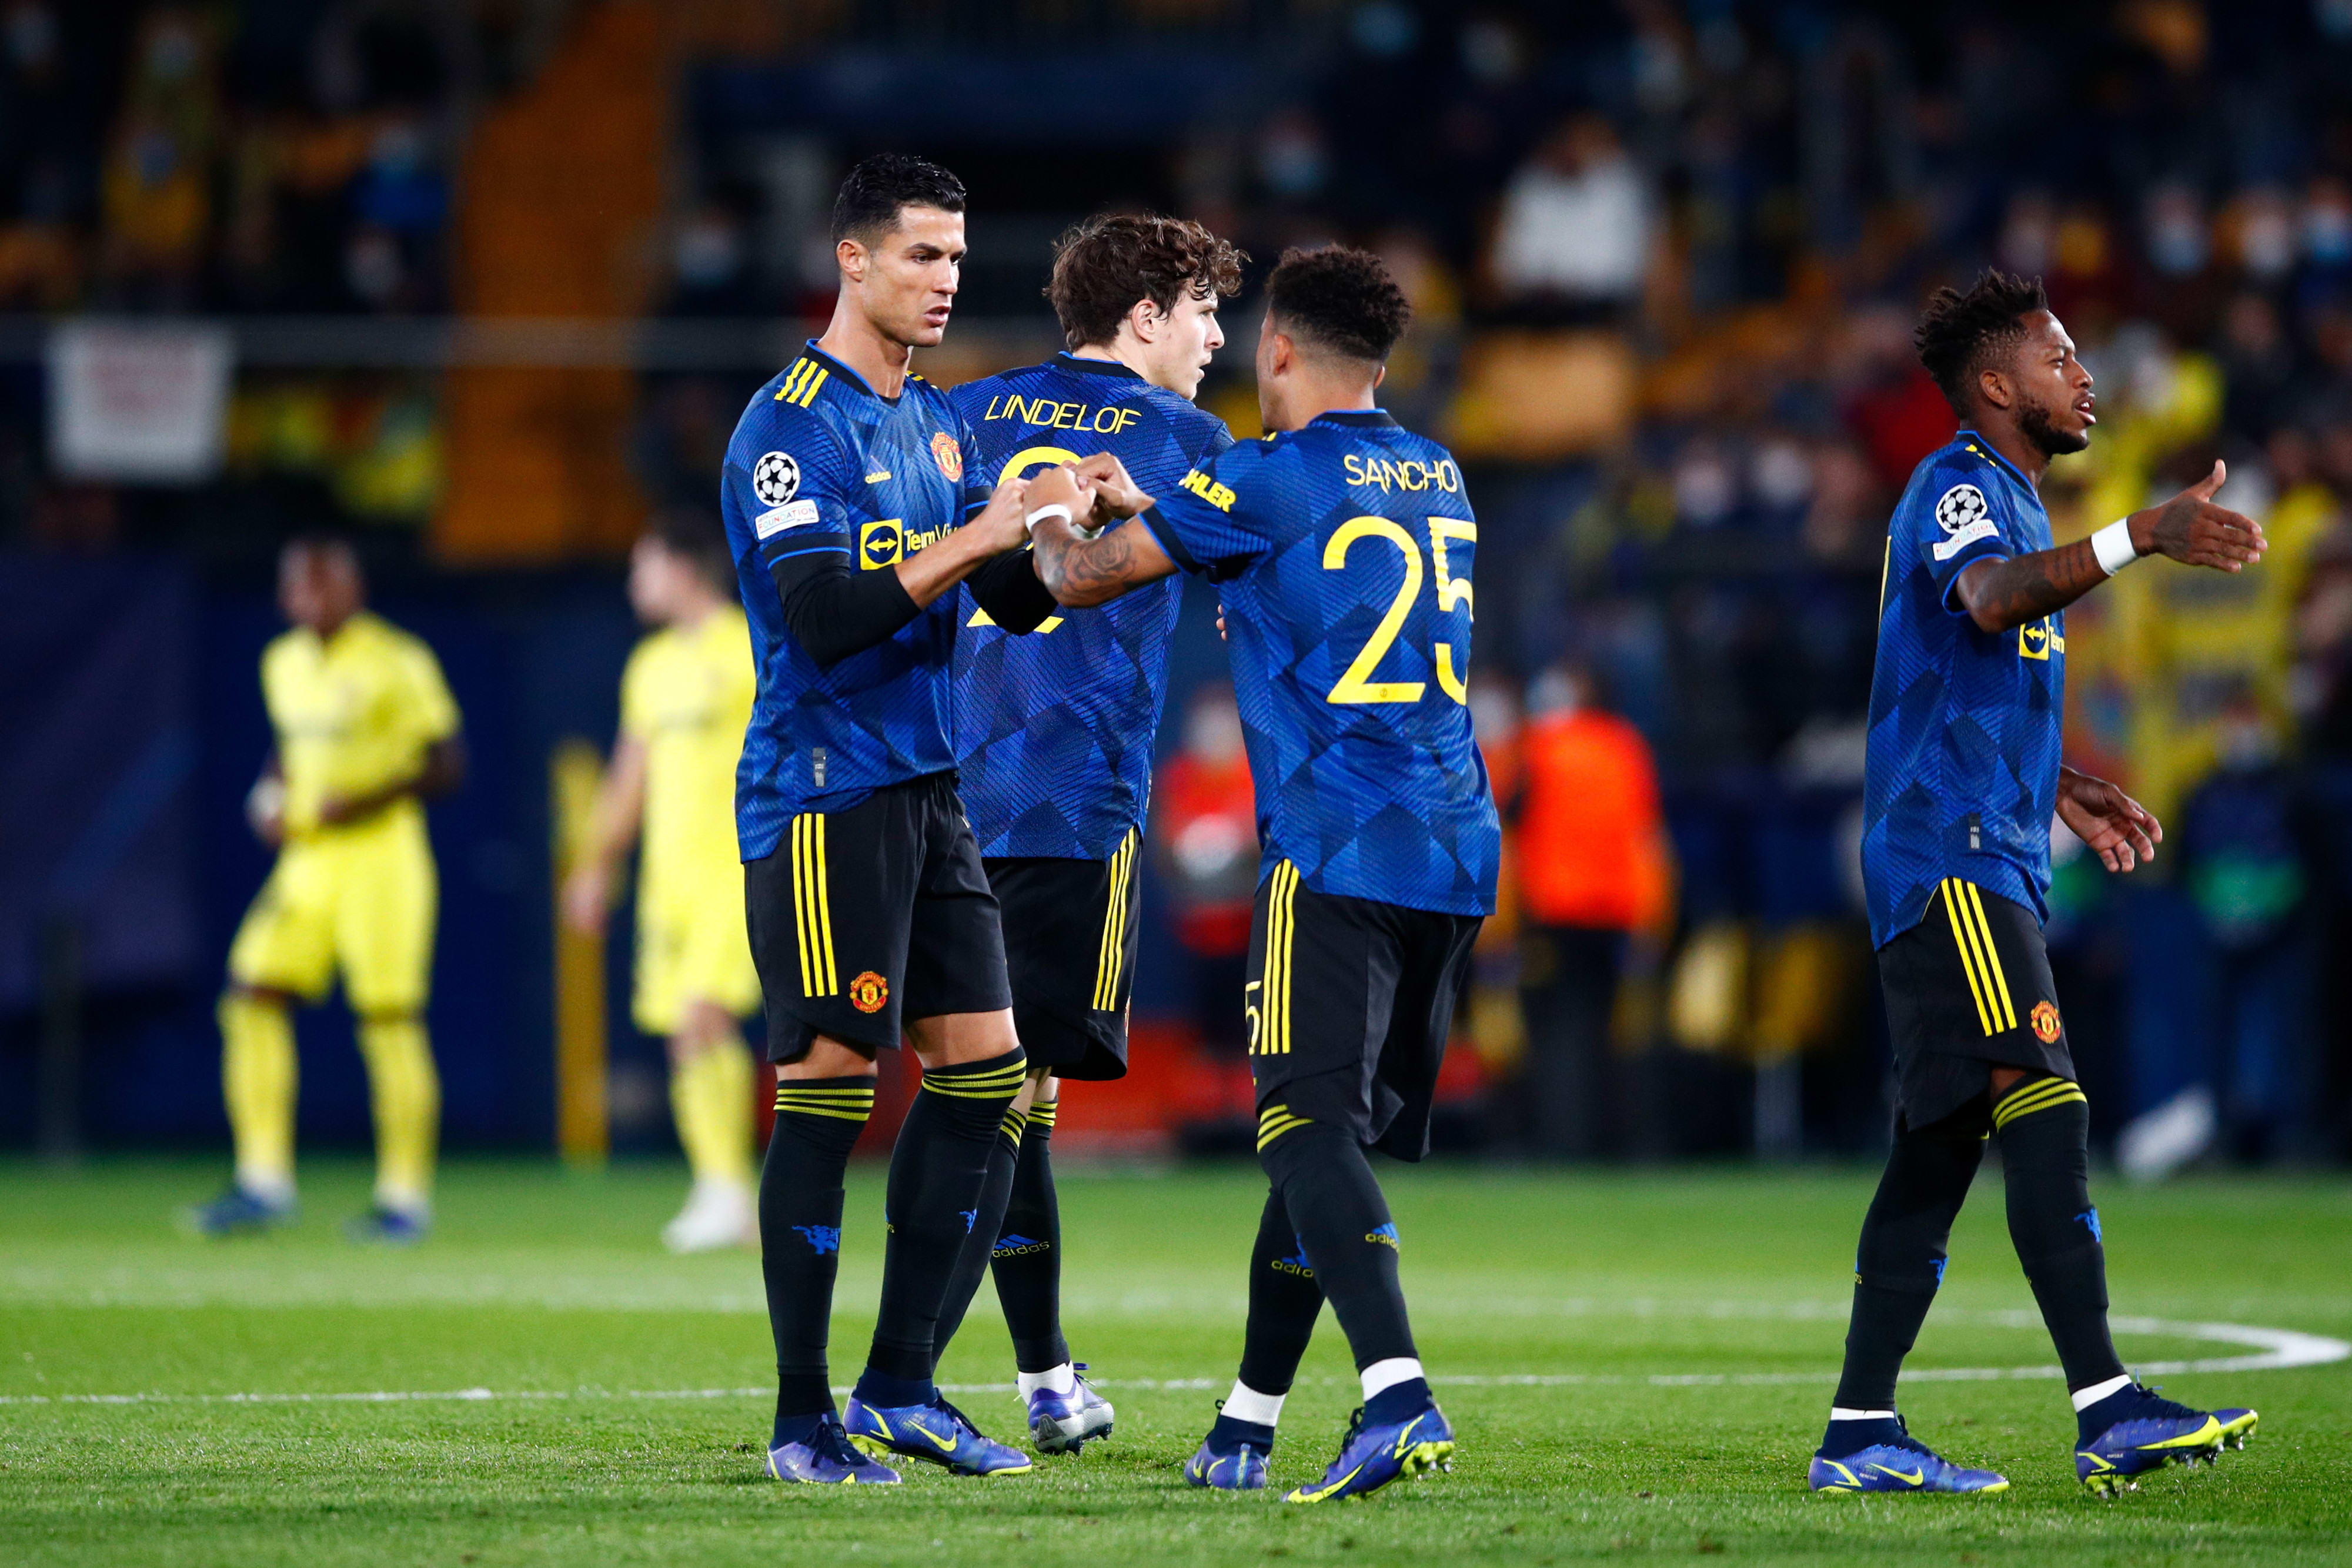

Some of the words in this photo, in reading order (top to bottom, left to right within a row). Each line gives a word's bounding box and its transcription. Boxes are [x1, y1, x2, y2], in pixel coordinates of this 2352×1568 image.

[984, 394, 1142, 434] LINDELOF
[1344, 454, 1458, 496] SANCHO
[758, 508, 815, 531] FOUNDATION
[1322, 516, 1477, 706] 25
